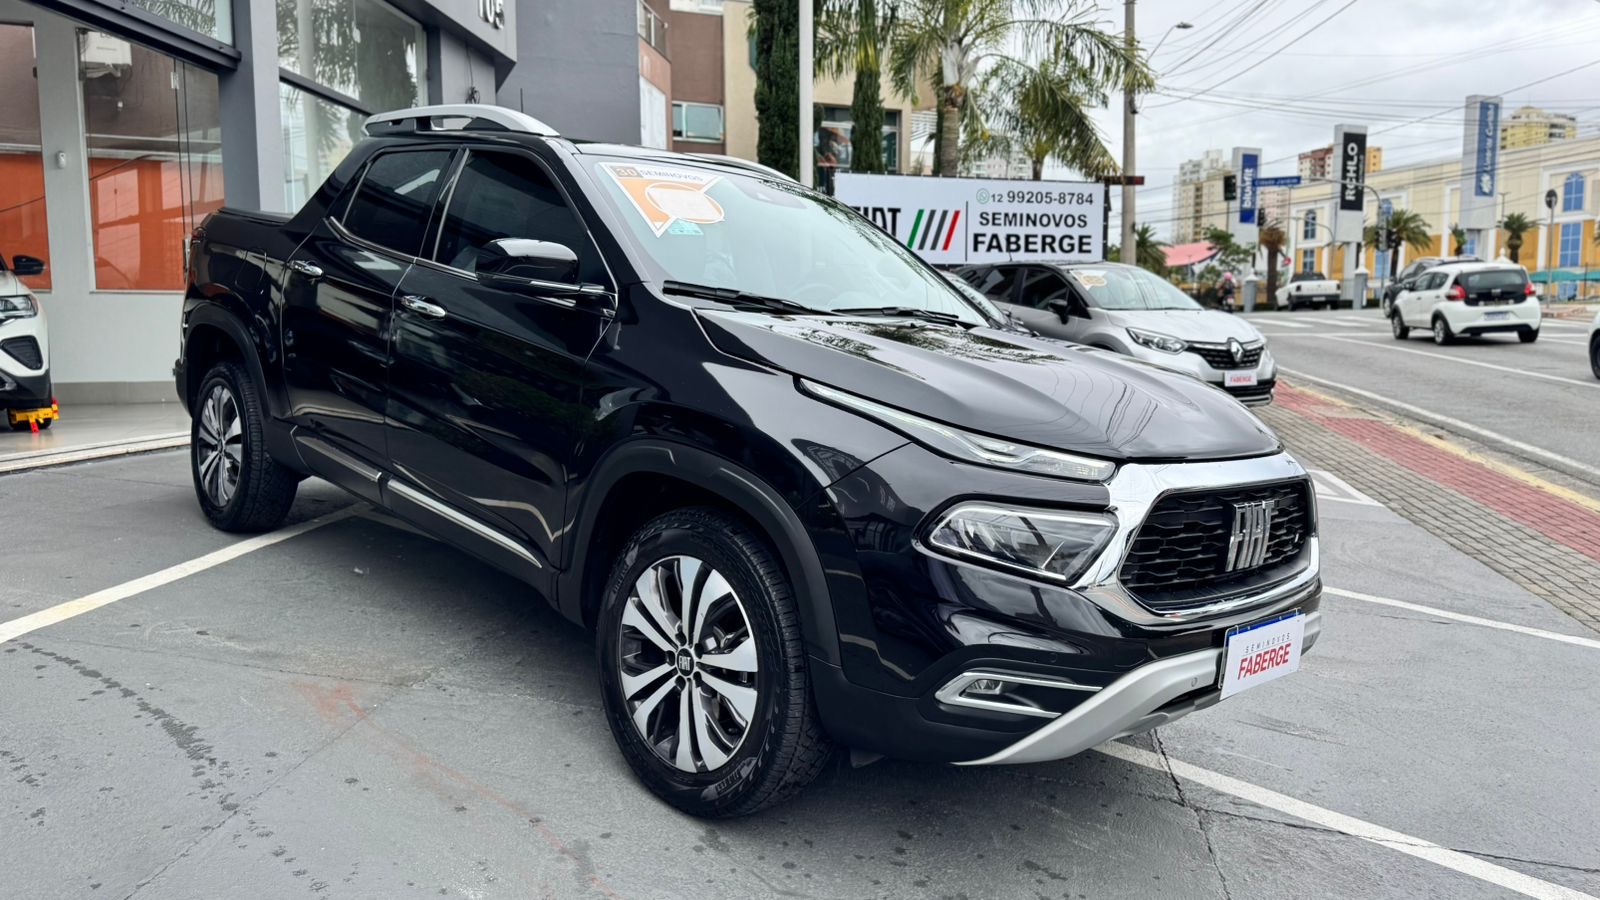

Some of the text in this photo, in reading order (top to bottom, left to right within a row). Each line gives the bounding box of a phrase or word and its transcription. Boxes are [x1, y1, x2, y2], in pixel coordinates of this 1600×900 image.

[991, 190, 1094, 206] 12 99205-8784
[979, 211, 1088, 228] SEMINOVOS
[972, 233, 1092, 254] FABERGE
[1225, 500, 1275, 572] FIAT
[1245, 632, 1290, 653] SEMINOVOS
[678, 655, 692, 671] FIAT
[1237, 642, 1291, 680] FABERGE
